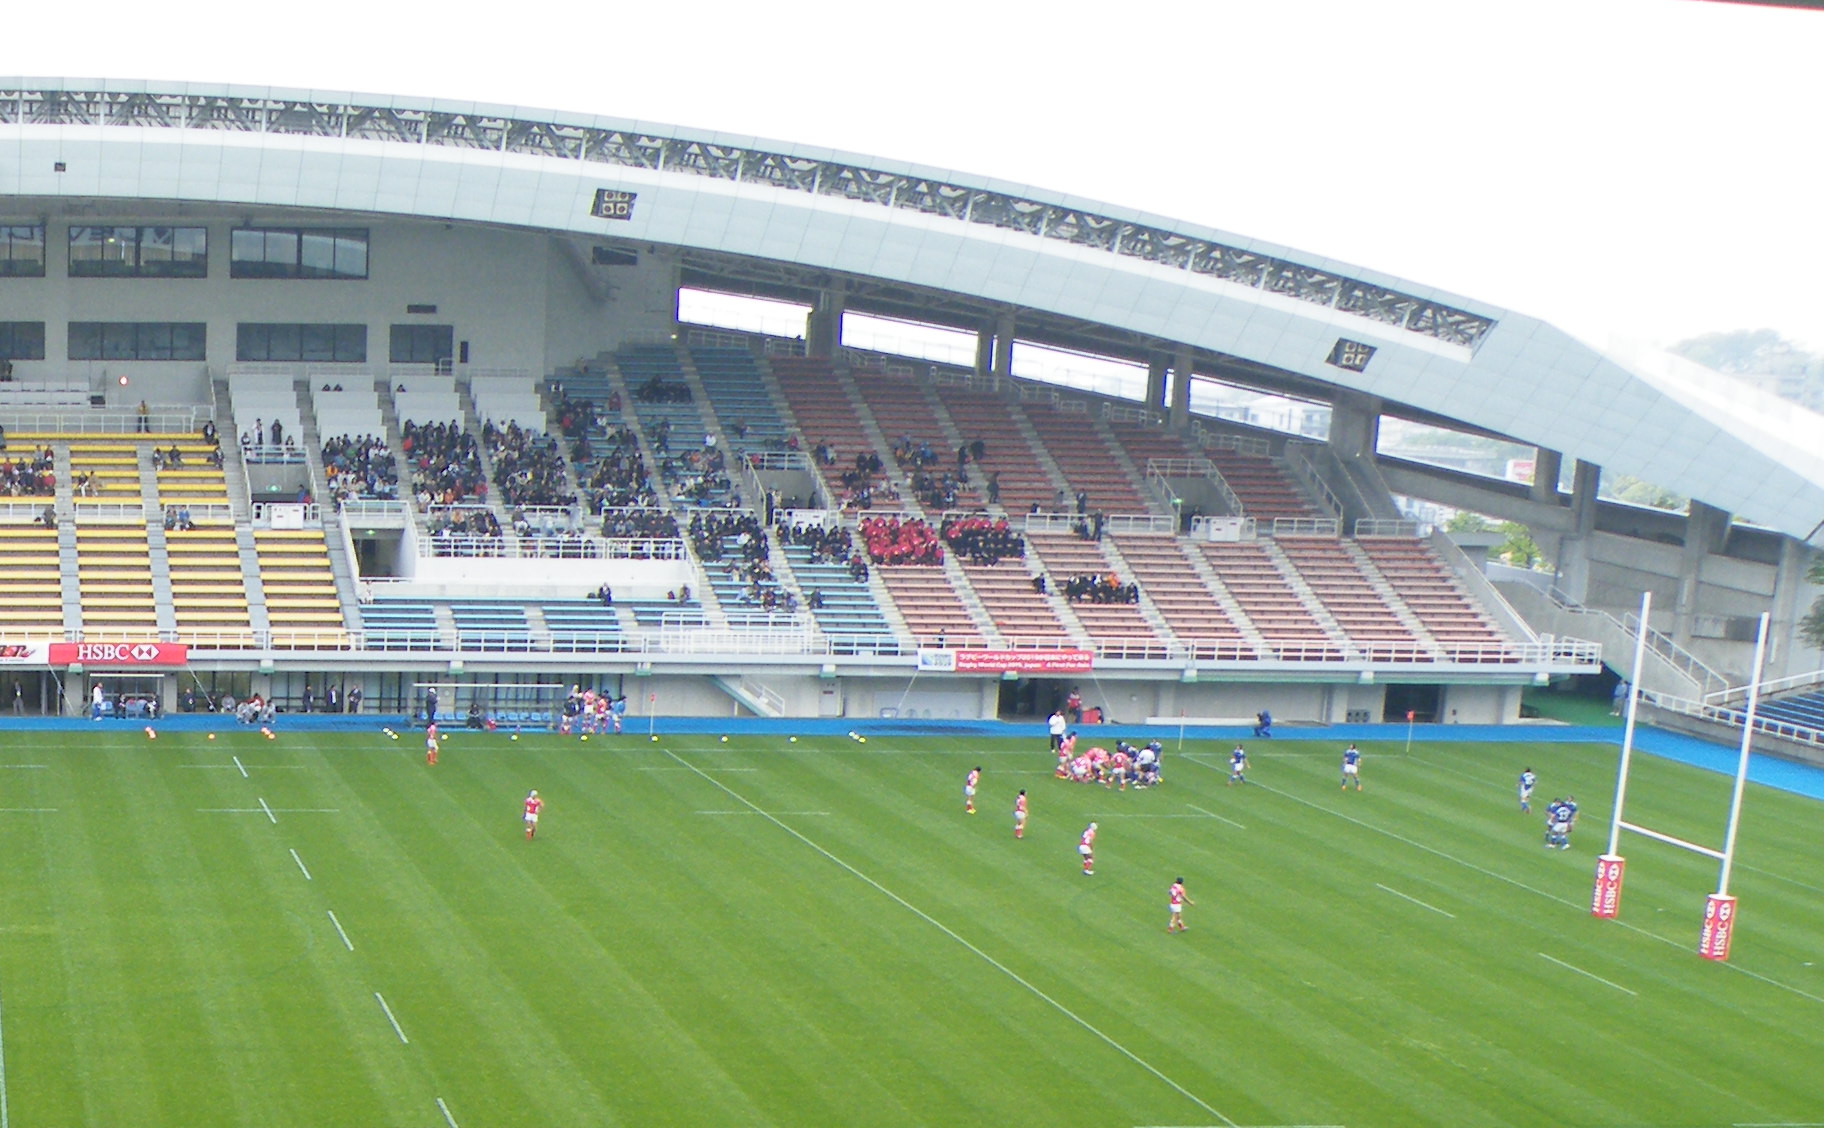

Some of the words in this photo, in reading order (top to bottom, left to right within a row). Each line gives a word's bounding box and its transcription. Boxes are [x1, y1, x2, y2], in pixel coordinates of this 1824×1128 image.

[77, 643, 130, 661] HSBC
[1603, 881, 1618, 915] HSBC
[1713, 921, 1728, 957] HSBC
